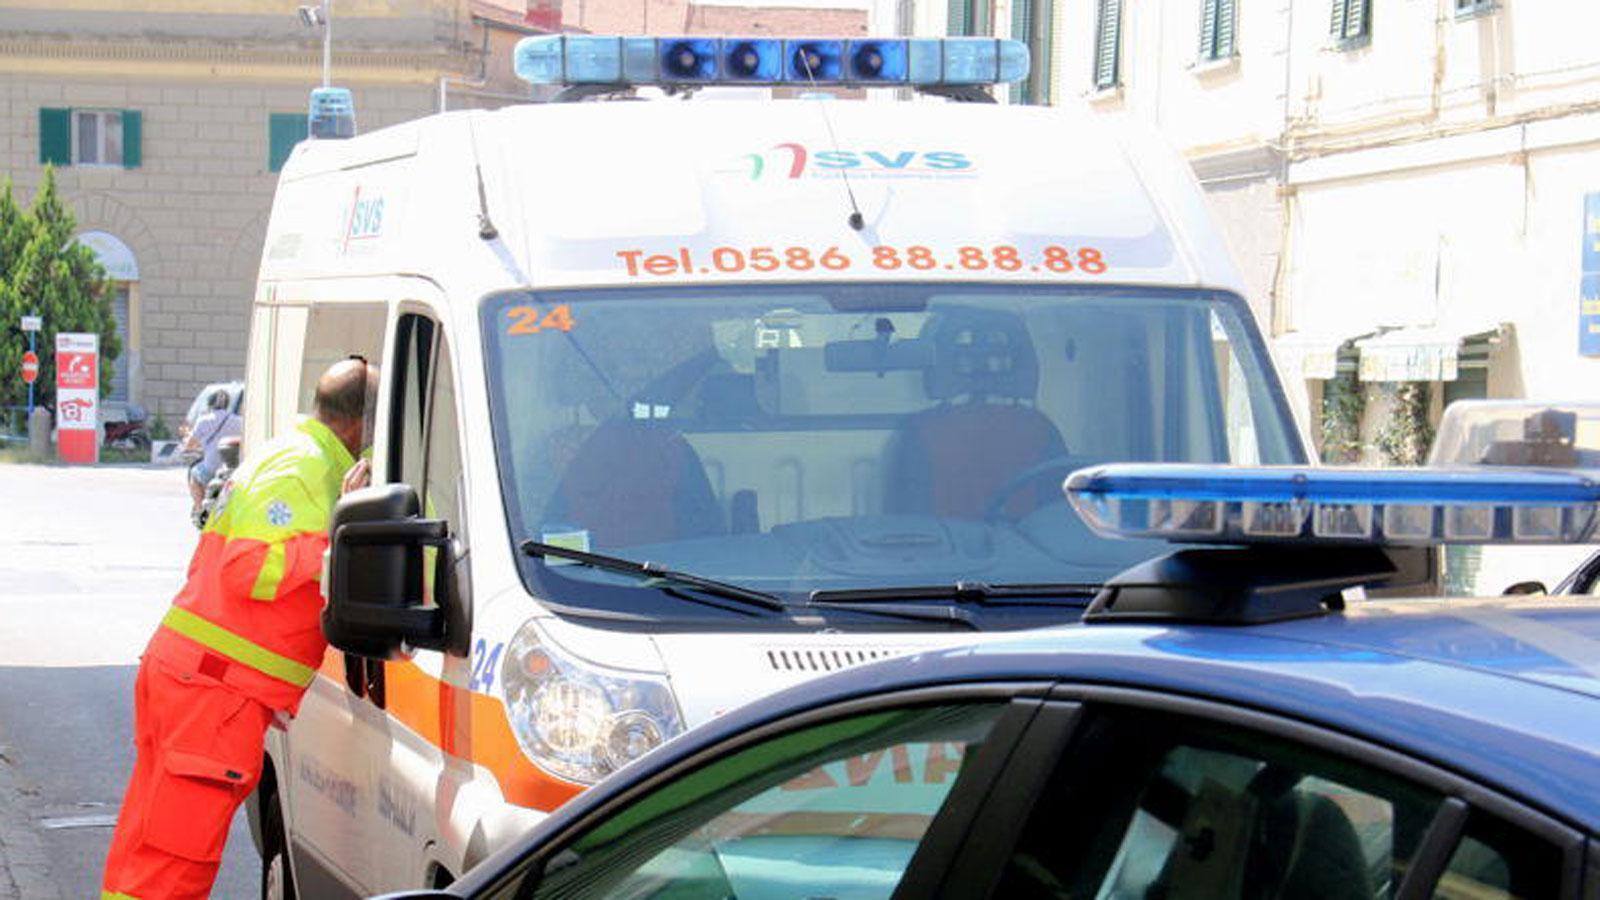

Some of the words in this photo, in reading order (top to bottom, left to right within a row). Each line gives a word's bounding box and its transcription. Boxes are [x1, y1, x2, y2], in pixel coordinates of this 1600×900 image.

[814, 151, 972, 169] SVS
[351, 198, 384, 236] SVS
[616, 246, 850, 277] Tel.0586
[872, 245, 1108, 275] 88.88.88
[507, 304, 575, 335] 24
[469, 638, 504, 694] 24
